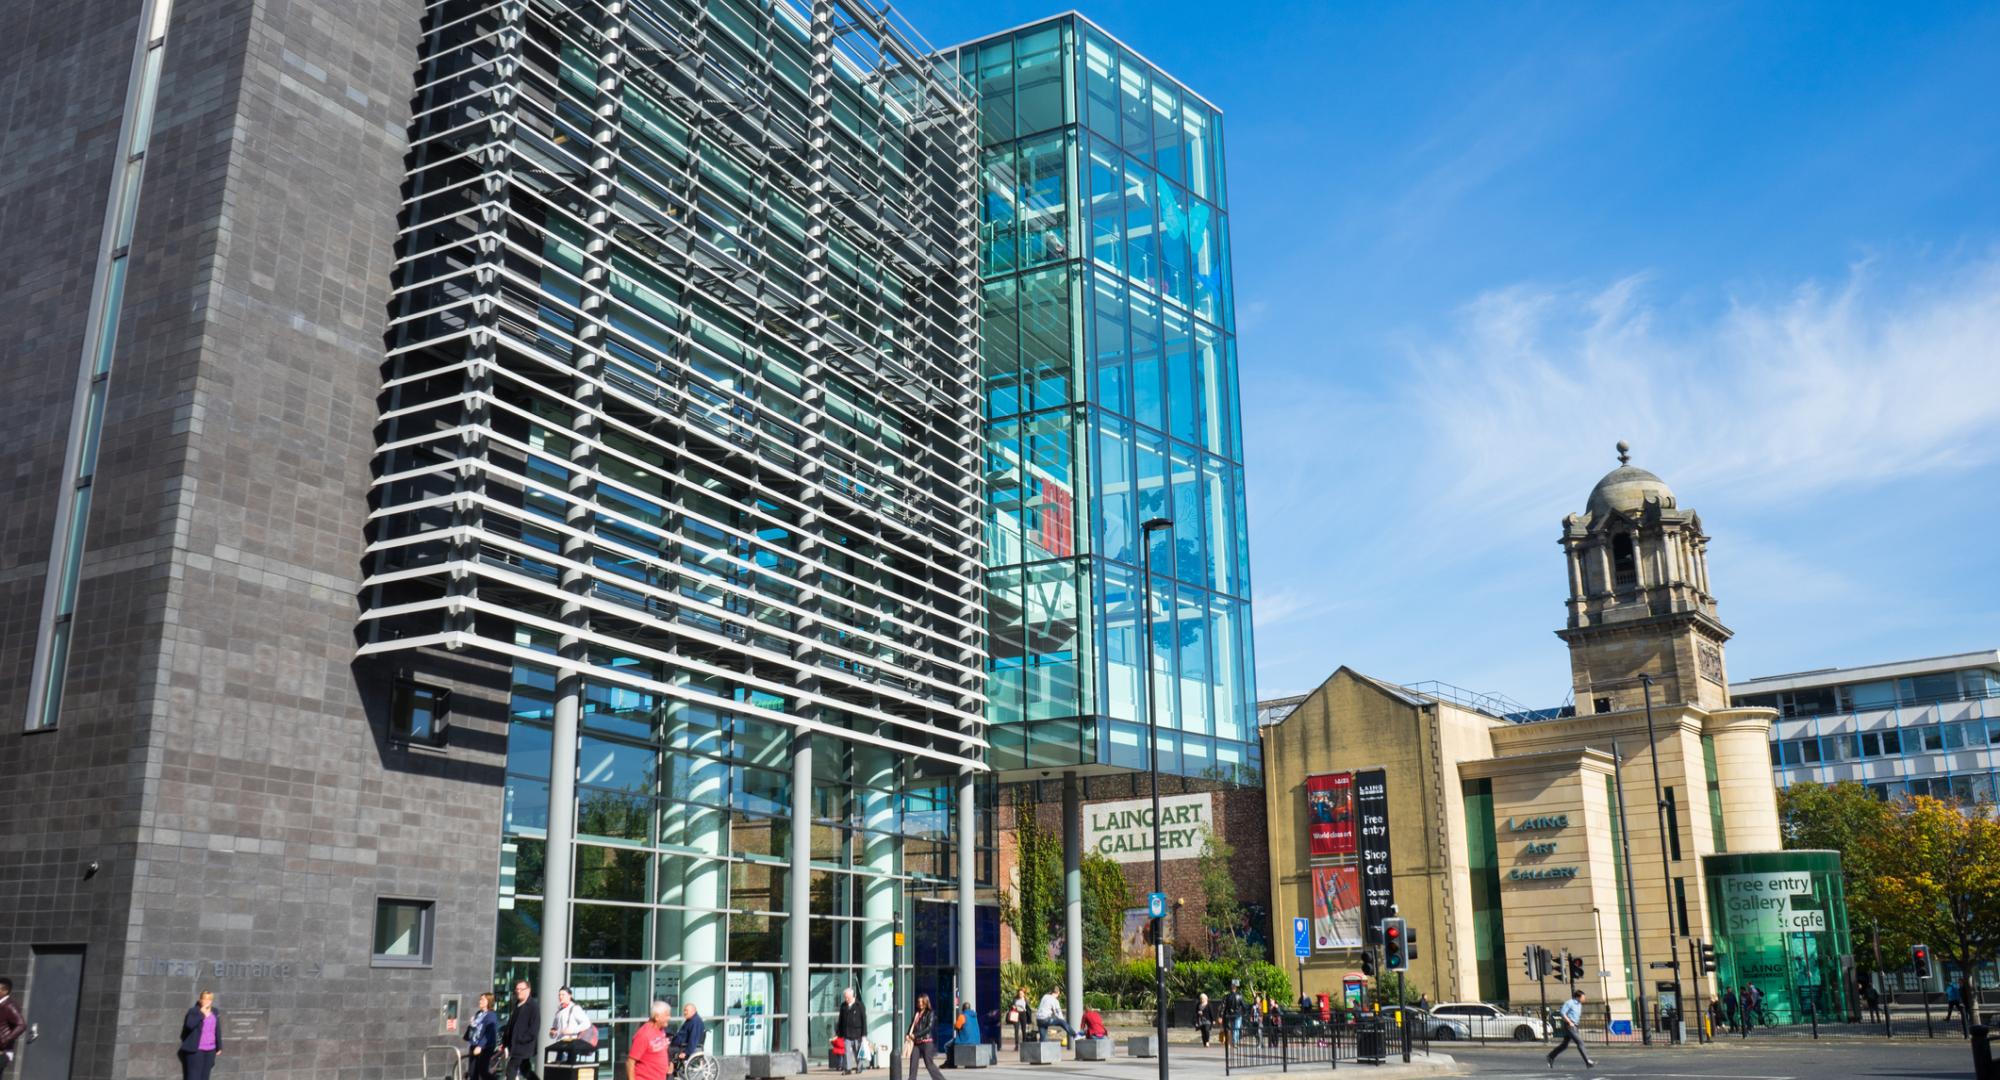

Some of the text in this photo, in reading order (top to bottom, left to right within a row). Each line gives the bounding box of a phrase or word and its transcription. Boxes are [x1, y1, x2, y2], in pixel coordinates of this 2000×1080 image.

[1160, 803, 1203, 826] ART
[1364, 815, 1383, 825] Free
[1509, 813, 1569, 832] LAING
[1362, 825, 1386, 837] entry
[1098, 828, 1197, 855] GALLERY
[1526, 841, 1557, 855] ART
[1364, 849, 1388, 862] Shop
[1508, 866, 1578, 881] GALLERY
[1728, 876, 1809, 893] Free entry
[1728, 895, 1786, 913] Gallery
[1793, 911, 1823, 927] cafe
[214, 959, 291, 979] entrance
